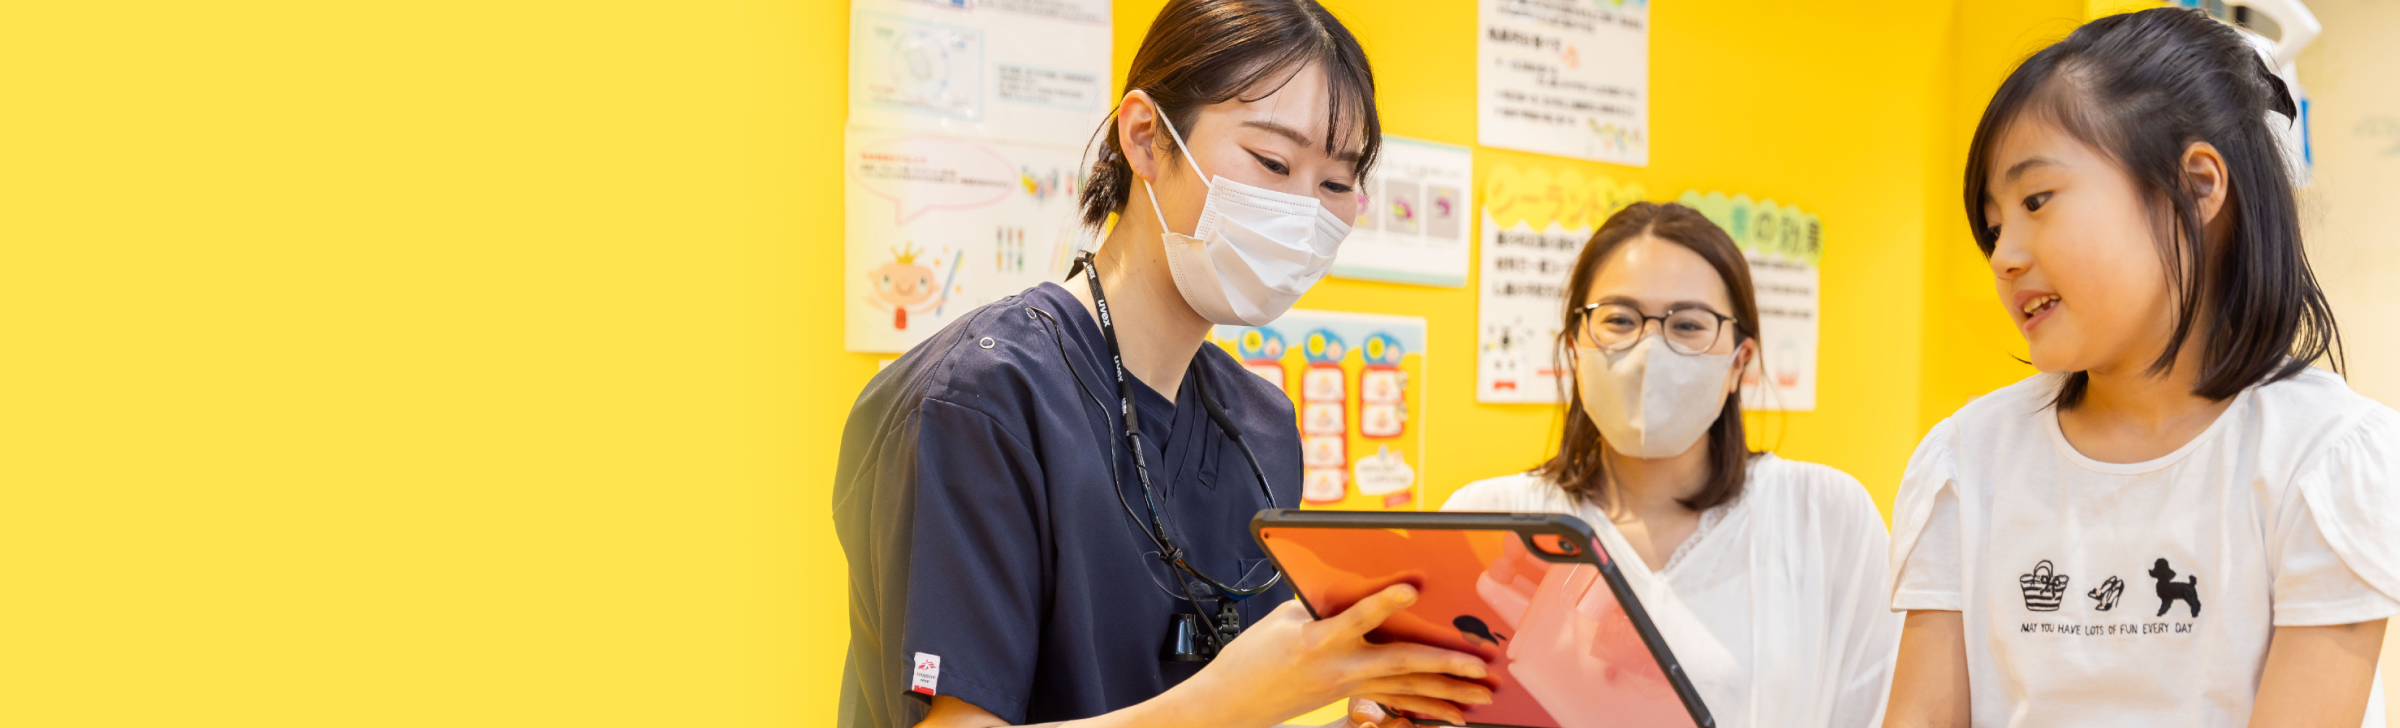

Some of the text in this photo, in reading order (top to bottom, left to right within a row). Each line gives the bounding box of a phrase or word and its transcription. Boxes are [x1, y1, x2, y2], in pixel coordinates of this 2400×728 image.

[1097, 299, 1111, 327] uvex
[1113, 354, 1124, 382] uvex
[2020, 622, 2193, 636] MAY YOU HAVE LOTS OF FUN EVERY DAY
